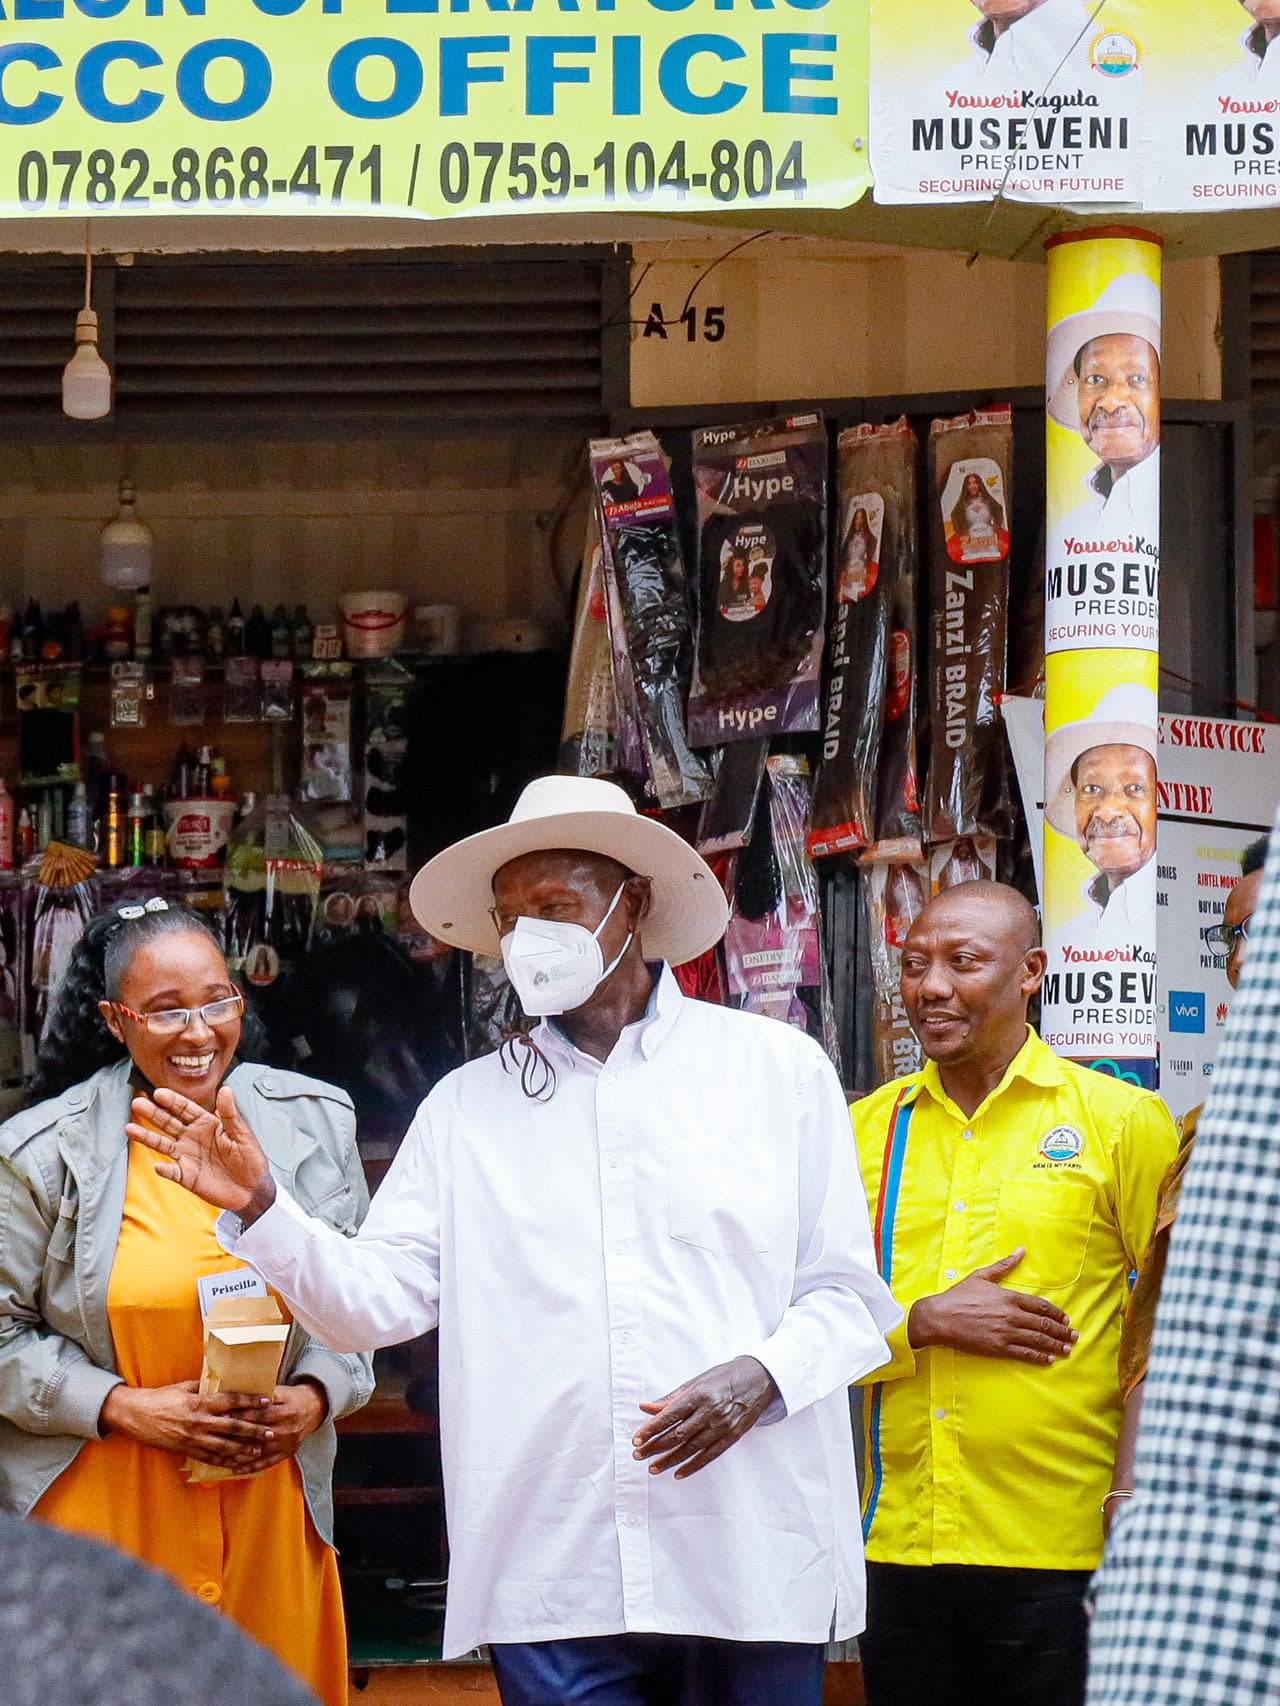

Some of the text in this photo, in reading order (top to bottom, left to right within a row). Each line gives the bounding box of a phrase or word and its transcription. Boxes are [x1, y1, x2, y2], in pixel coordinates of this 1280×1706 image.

[327, 33, 839, 119] OFFICE
[912, 116, 1128, 151] MUSEVENI
[960, 154, 1084, 171] PRESIDENT
[19, 144, 383, 211] 0782-868-471
[439, 140, 808, 203] 0759-104-804
[919, 178, 1124, 194] SECURING YOUR FUTURE
[1192, 183, 1278, 198] SECURING
[643, 303, 726, 342] A 15
[703, 430, 736, 445] Hype
[733, 475, 794, 502] Hype
[735, 535, 768, 549] Hype
[1047, 562, 1160, 601] MUSEV
[1075, 599, 1159, 619] PRESIDE
[945, 570, 974, 749] Zanzi BRAID
[823, 604, 850, 760] anzi BRAID
[718, 704, 778, 732] Hype
[1170, 718, 1266, 754] SERVICE
[1197, 873, 1219, 888] AIRTEL
[1199, 900, 1225, 915] BUY DAT
[1200, 955, 1212, 968] PAY
[1043, 971, 1158, 1005] MUSEV
[1072, 1008, 1157, 1024] PRESIDE
[1175, 1002, 1199, 1017] vivo
[211, 1279, 257, 1296] Priscilla
